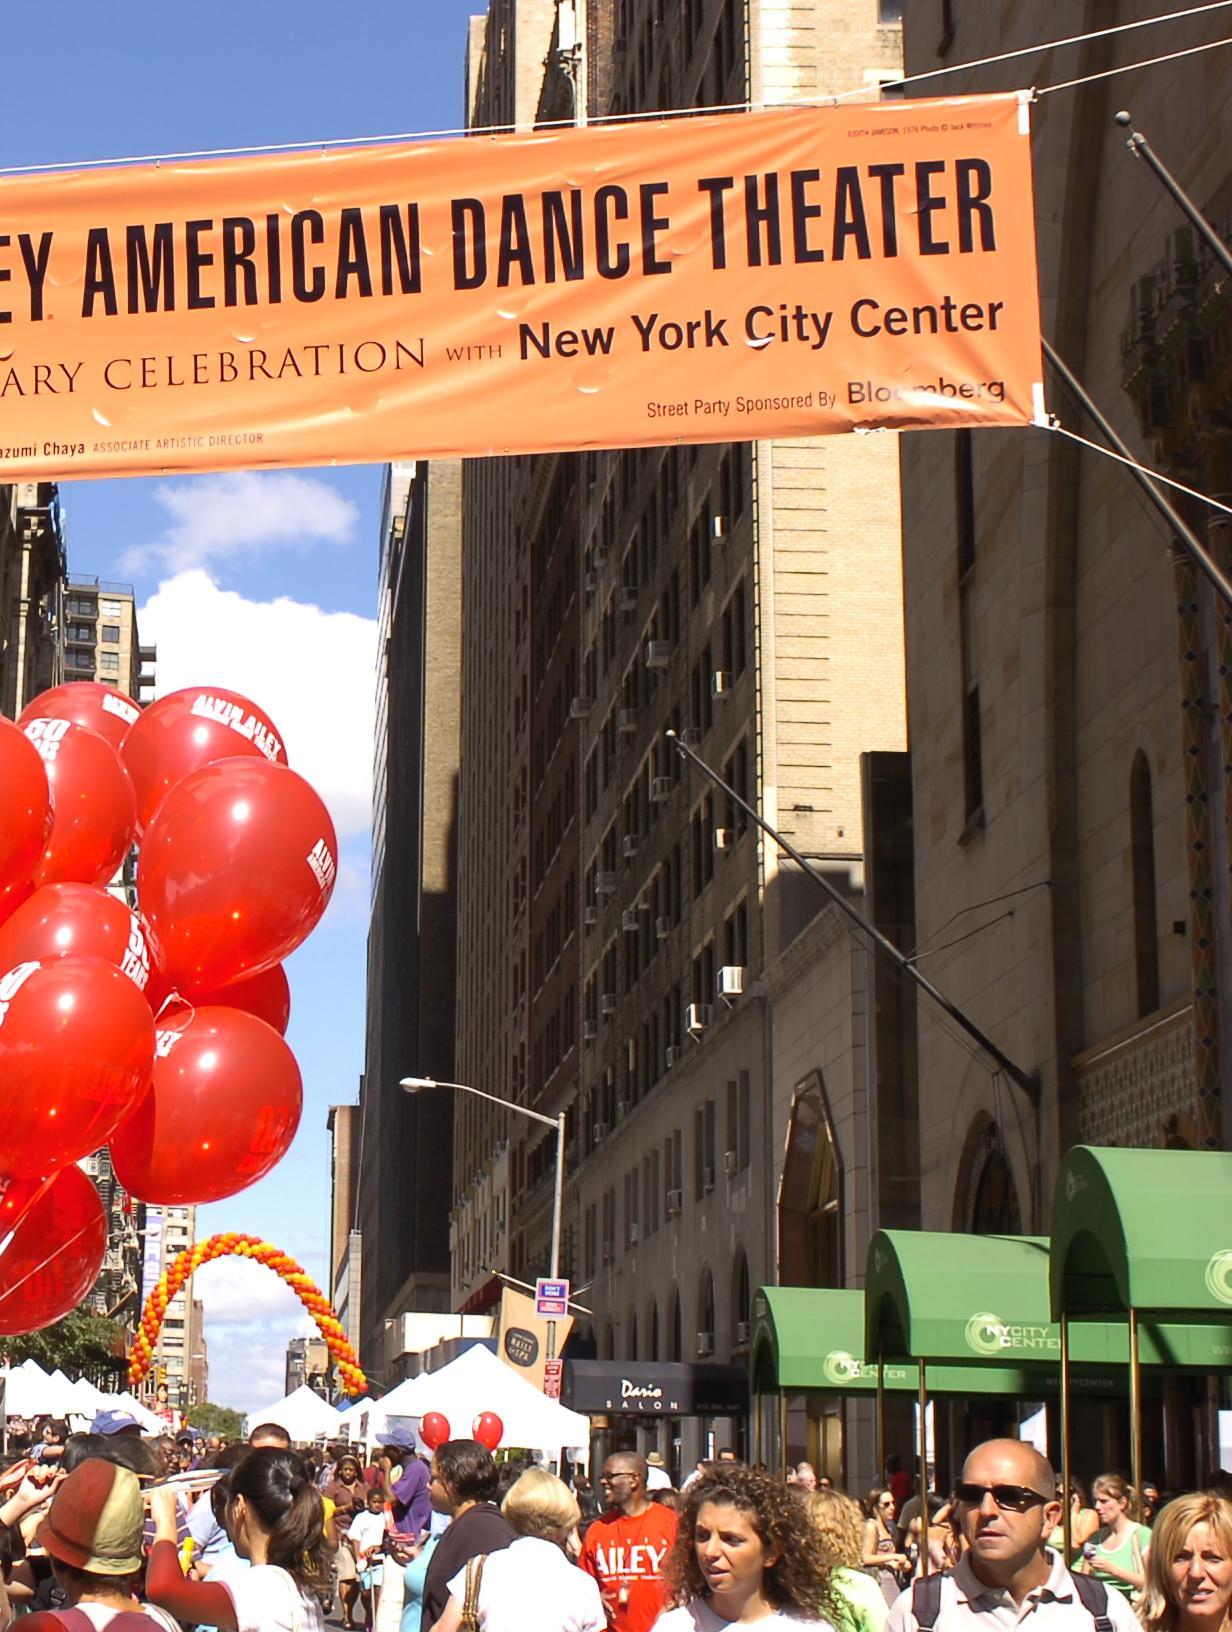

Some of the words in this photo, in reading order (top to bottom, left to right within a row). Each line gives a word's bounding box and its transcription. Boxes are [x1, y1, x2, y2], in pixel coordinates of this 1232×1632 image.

[81, 202, 423, 319] AMERICAN
[451, 181, 673, 292] DANCE
[698, 157, 997, 271] THEATER
[104, 338, 426, 391] CELEBRATION
[446, 344, 502, 363] WITH
[519, 322, 615, 360] New
[632, 306, 729, 352] York
[745, 302, 833, 351] City
[849, 296, 1004, 337] Center
[647, 398, 690, 418] Street
[694, 397, 730, 417] Party
[735, 392, 813, 413] Sponsored
[818, 391, 836, 410] By
[43, 440, 85, 459] Chaya
[93, 437, 151, 455] ASSOCIATE
[156, 435, 204, 450] ARTISTIC
[209, 432, 264, 447] DIRECTOR
[23, 717, 72, 742] 50
[621, 1379, 663, 1398] Dario
[606, 1399, 679, 1410] SALON
